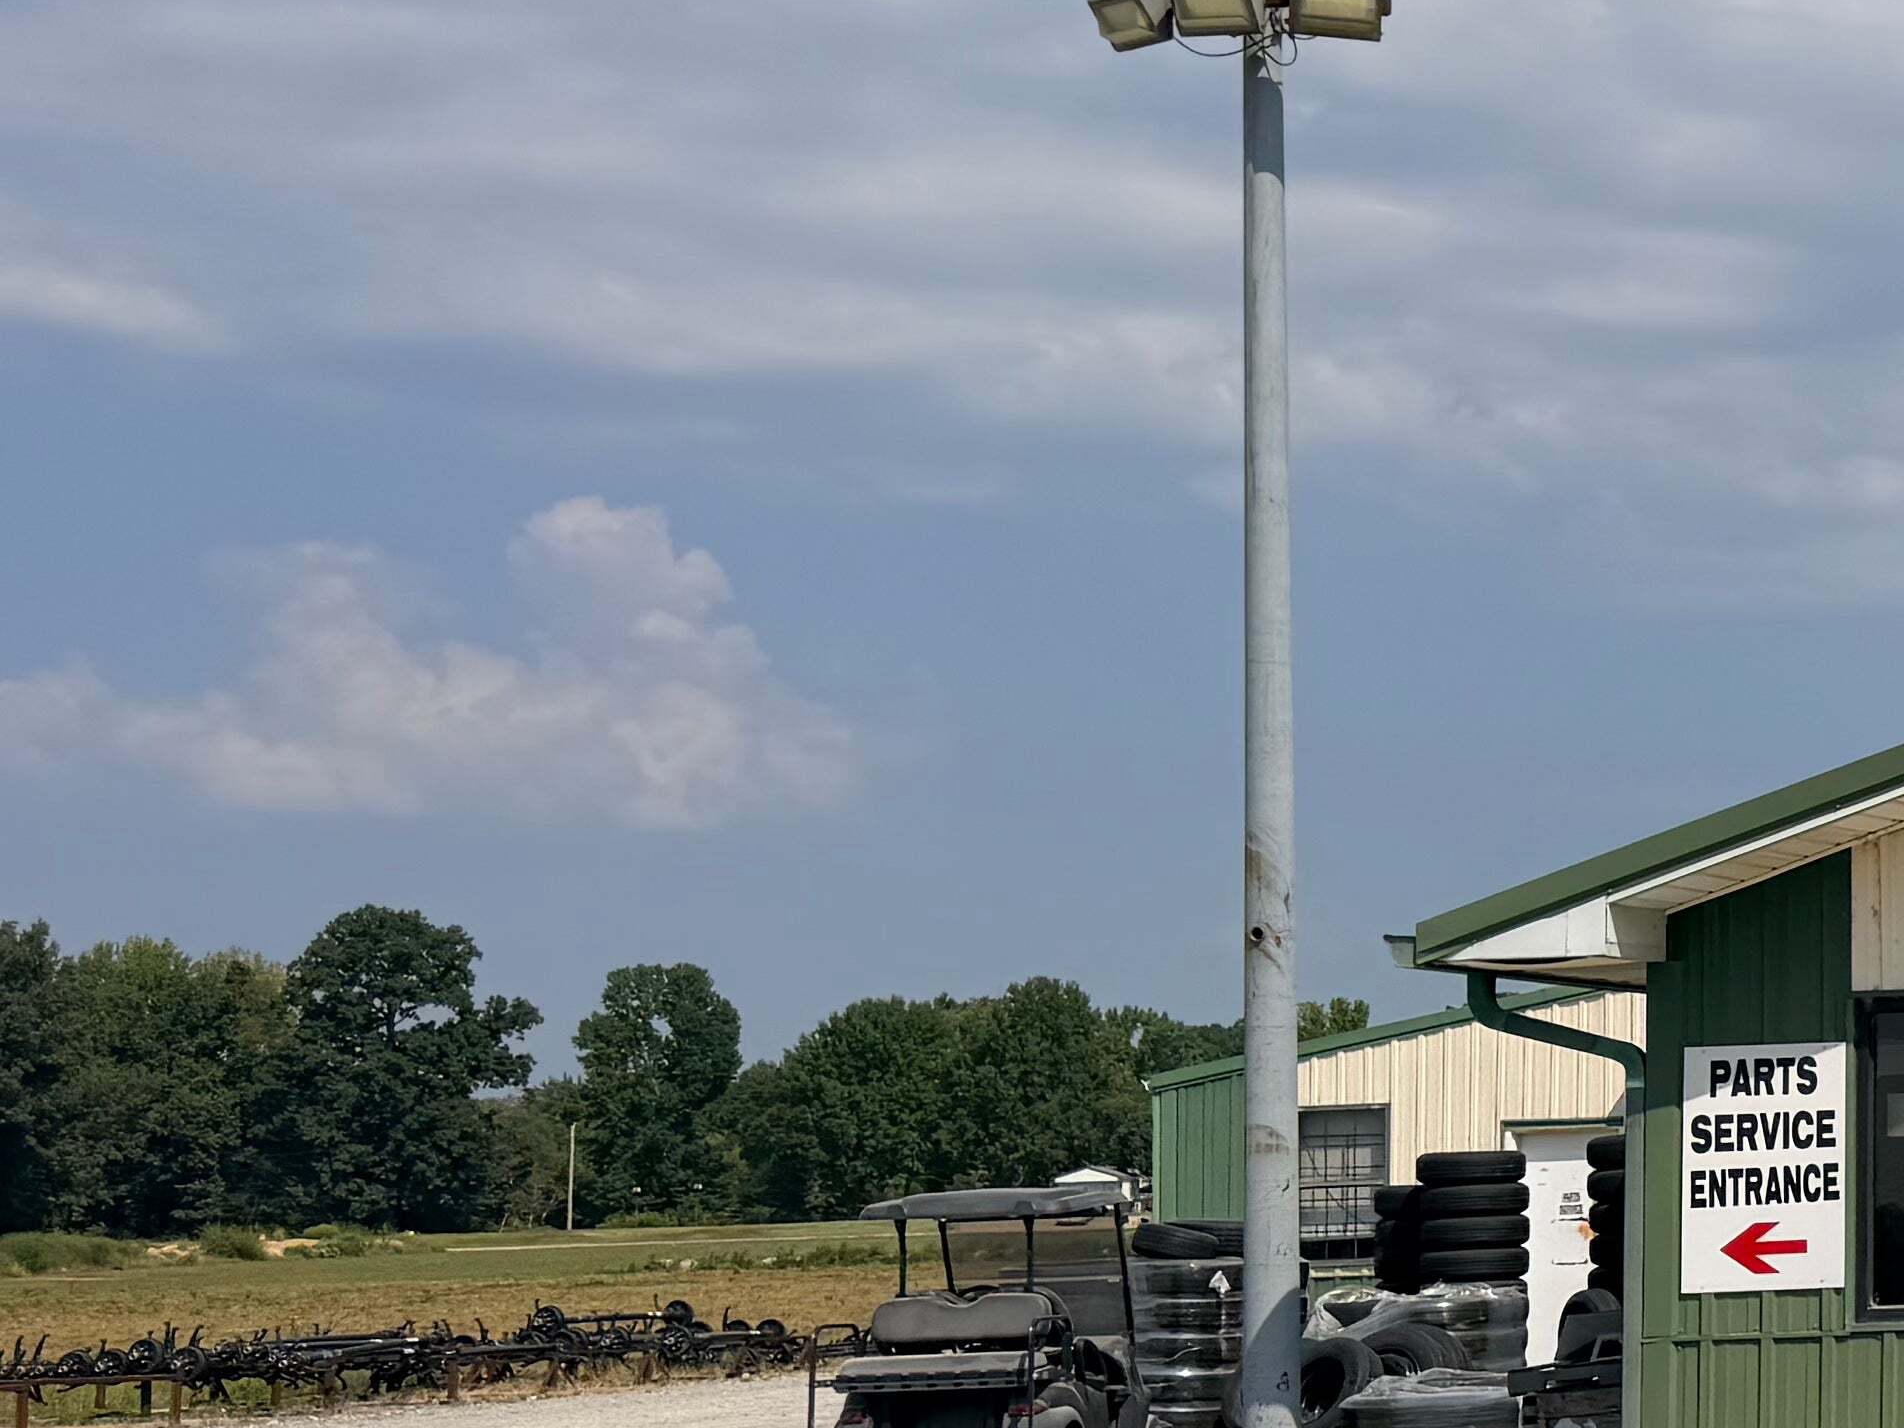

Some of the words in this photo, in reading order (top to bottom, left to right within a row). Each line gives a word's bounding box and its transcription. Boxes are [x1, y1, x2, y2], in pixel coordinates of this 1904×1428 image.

[1710, 1056, 1818, 1097] PARTS
[1691, 1110, 1837, 1153] SERVICE
[1690, 1163, 1840, 1208] ENTRANCE
